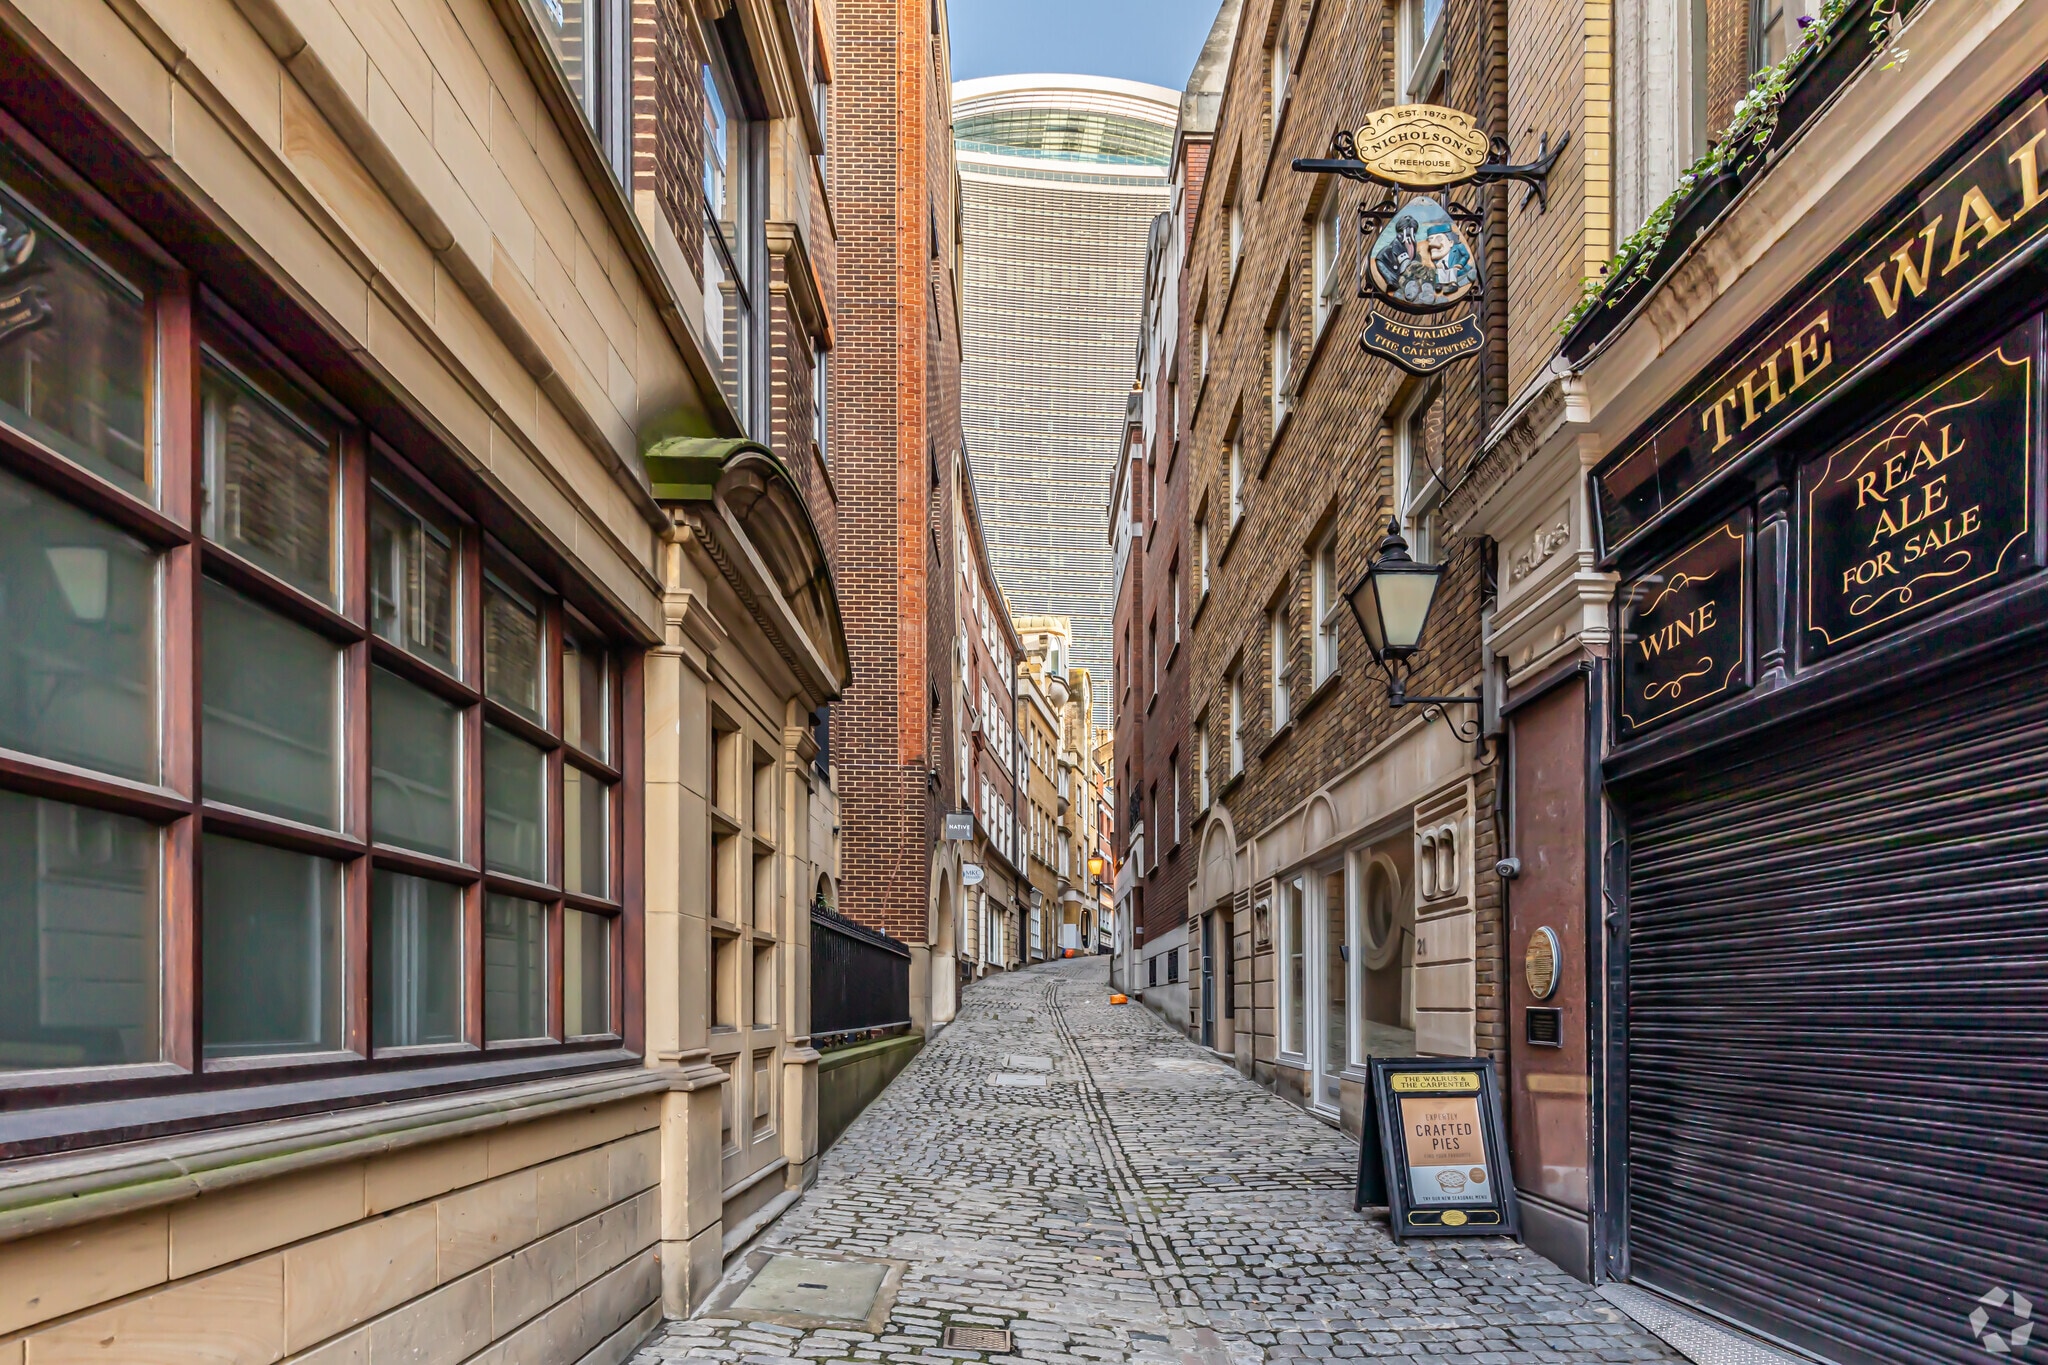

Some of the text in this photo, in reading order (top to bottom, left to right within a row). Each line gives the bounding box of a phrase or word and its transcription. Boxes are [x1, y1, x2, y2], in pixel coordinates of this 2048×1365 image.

[1397, 109, 1447, 120] EST. 1873
[1371, 131, 1474, 156] NICHOLSON'S
[1393, 159, 1451, 167] FREEHOUSE
[1702, 128, 2048, 454] THE WAL
[1385, 321, 1464, 339] THE WALRUS
[1375, 333, 1478, 356] THE CARPENTER
[1856, 423, 1966, 510] REAL
[1868, 474, 1949, 548] ALE
[1842, 505, 1982, 595] FOR SALE
[1639, 600, 1717, 661] WINE
[1417, 938, 1426, 955] 21
[1415, 1123, 1472, 1137] CRAFTED
[1432, 1137, 1460, 1150] PIES
